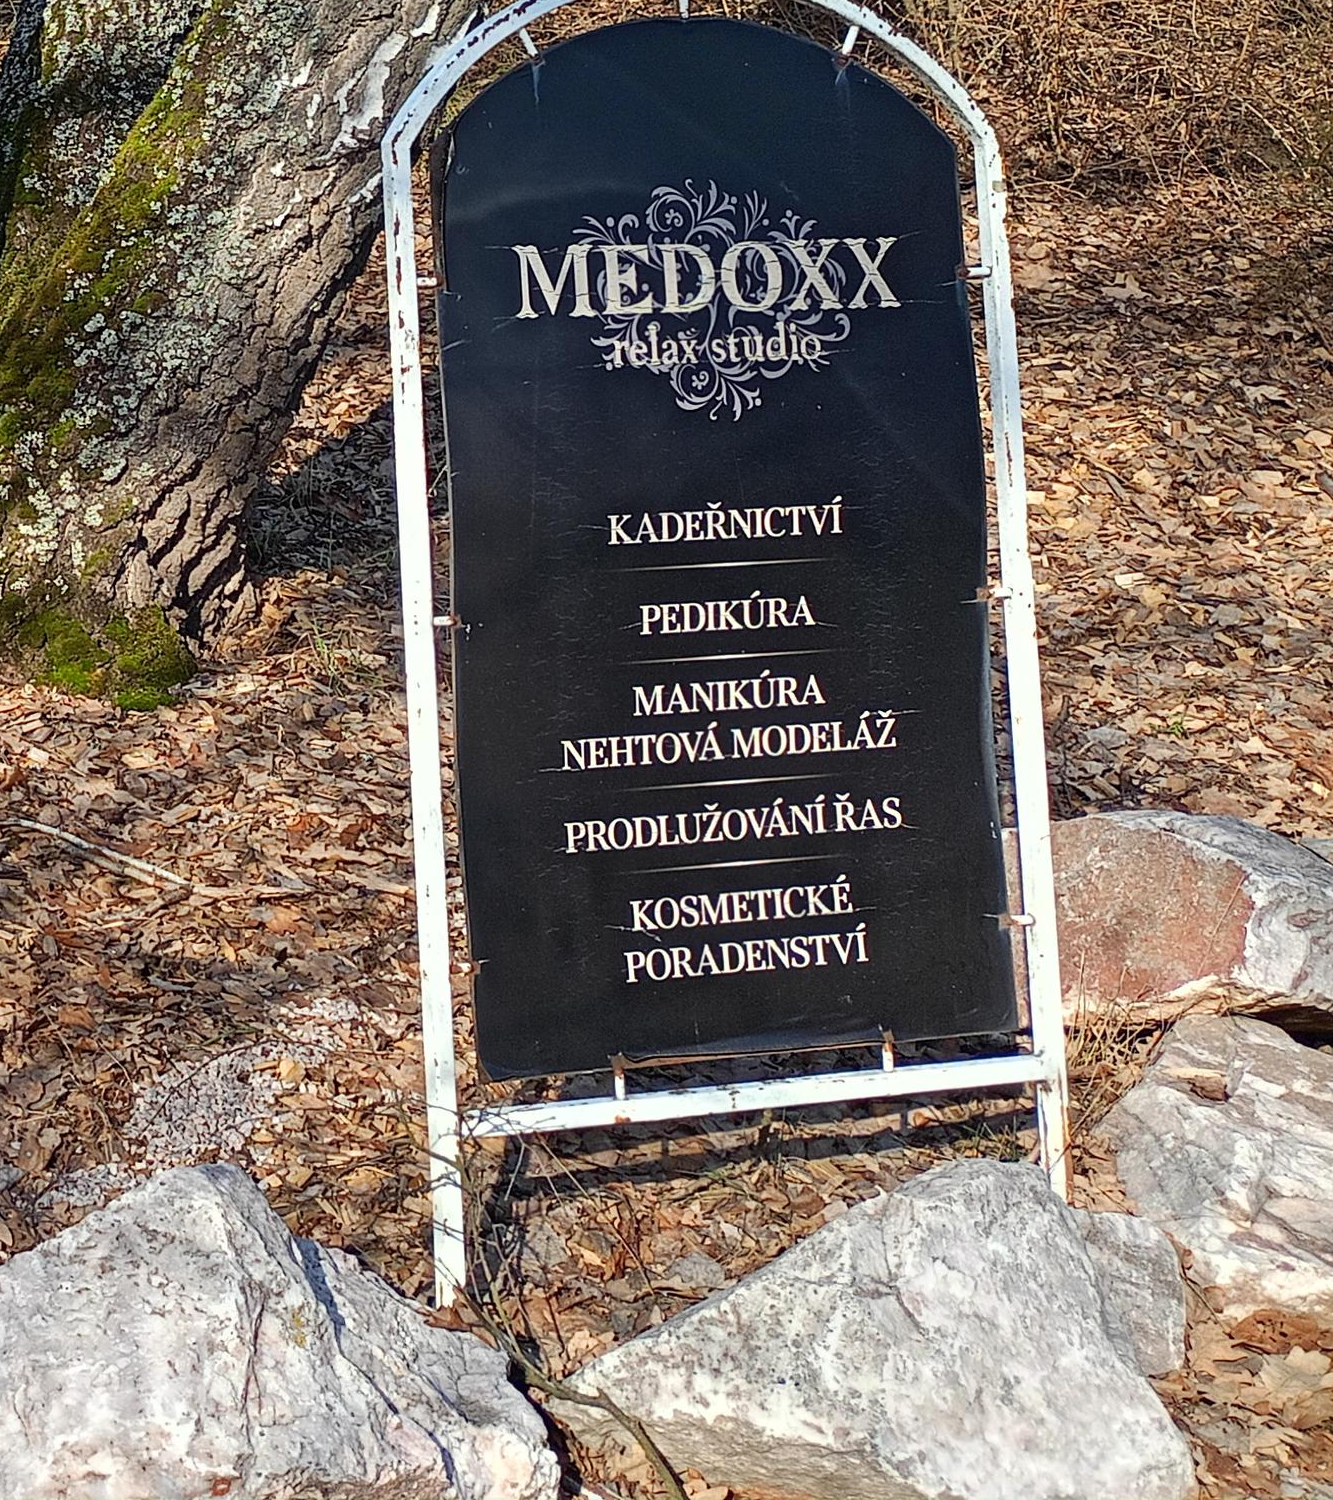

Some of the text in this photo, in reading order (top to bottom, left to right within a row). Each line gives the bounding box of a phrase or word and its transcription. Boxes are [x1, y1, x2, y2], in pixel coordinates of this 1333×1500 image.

[513, 237, 901, 318] MEDOXX
[614, 321, 822, 367] relax studio
[607, 496, 843, 545] KADEŘNICTVÍ
[639, 591, 816, 635] PEDIKÚRA
[632, 670, 826, 716] MANIKÚRA
[561, 710, 897, 770] NEHTOVÁ MODELÁŽ
[564, 792, 903, 853] PRODLUŽOVÁNÍ ŘAS
[630, 874, 854, 932] KOSMETICKÉ
[624, 923, 870, 983] PORADENSTVÍ
